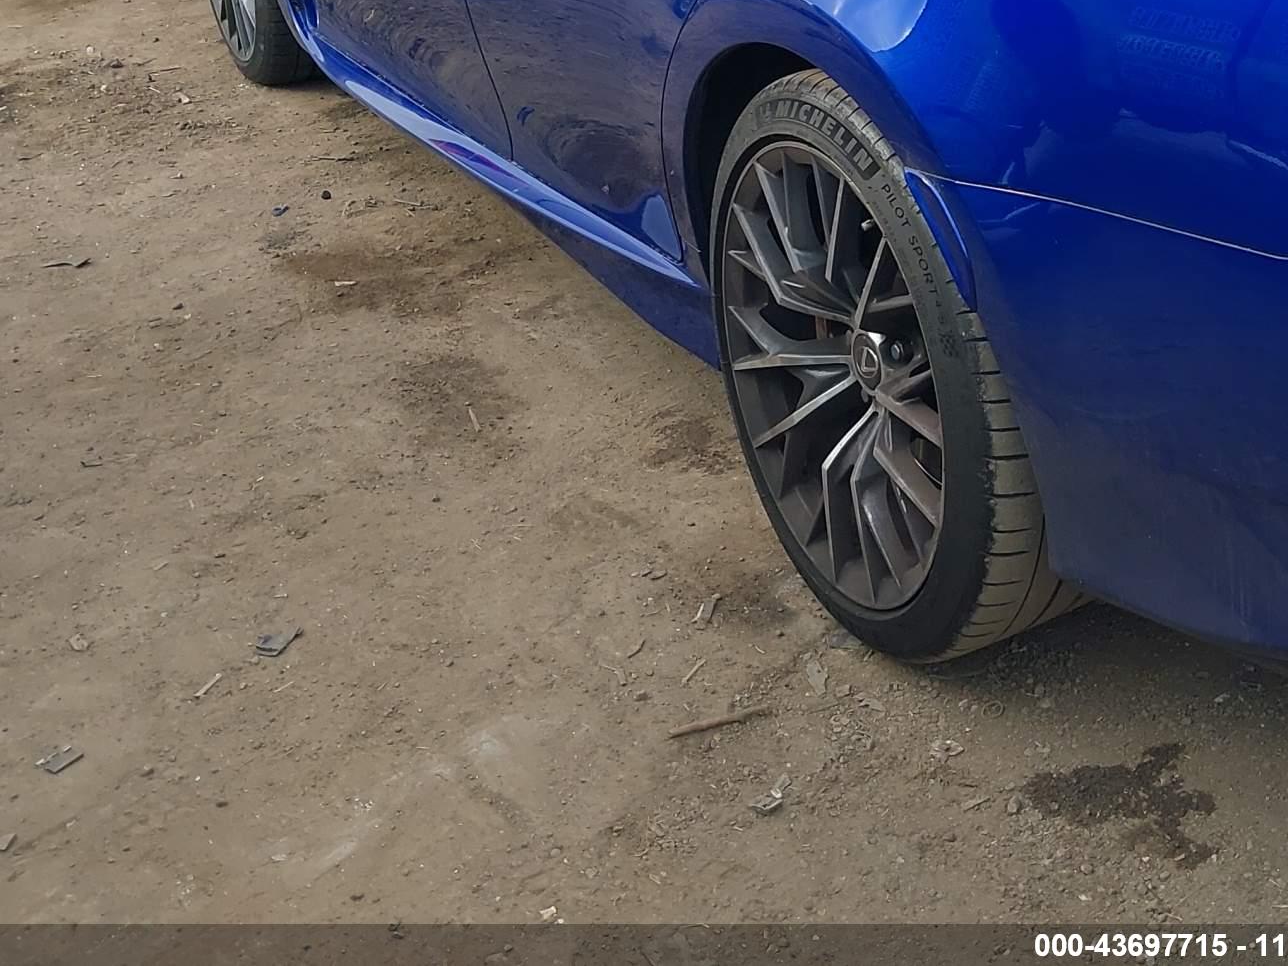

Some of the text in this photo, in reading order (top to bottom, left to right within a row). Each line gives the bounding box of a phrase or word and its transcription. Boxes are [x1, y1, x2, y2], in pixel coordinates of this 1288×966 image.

[775, 99, 874, 174] MICHELIN
[881, 183, 911, 229] PILOT
[907, 237, 940, 296] SPORT
